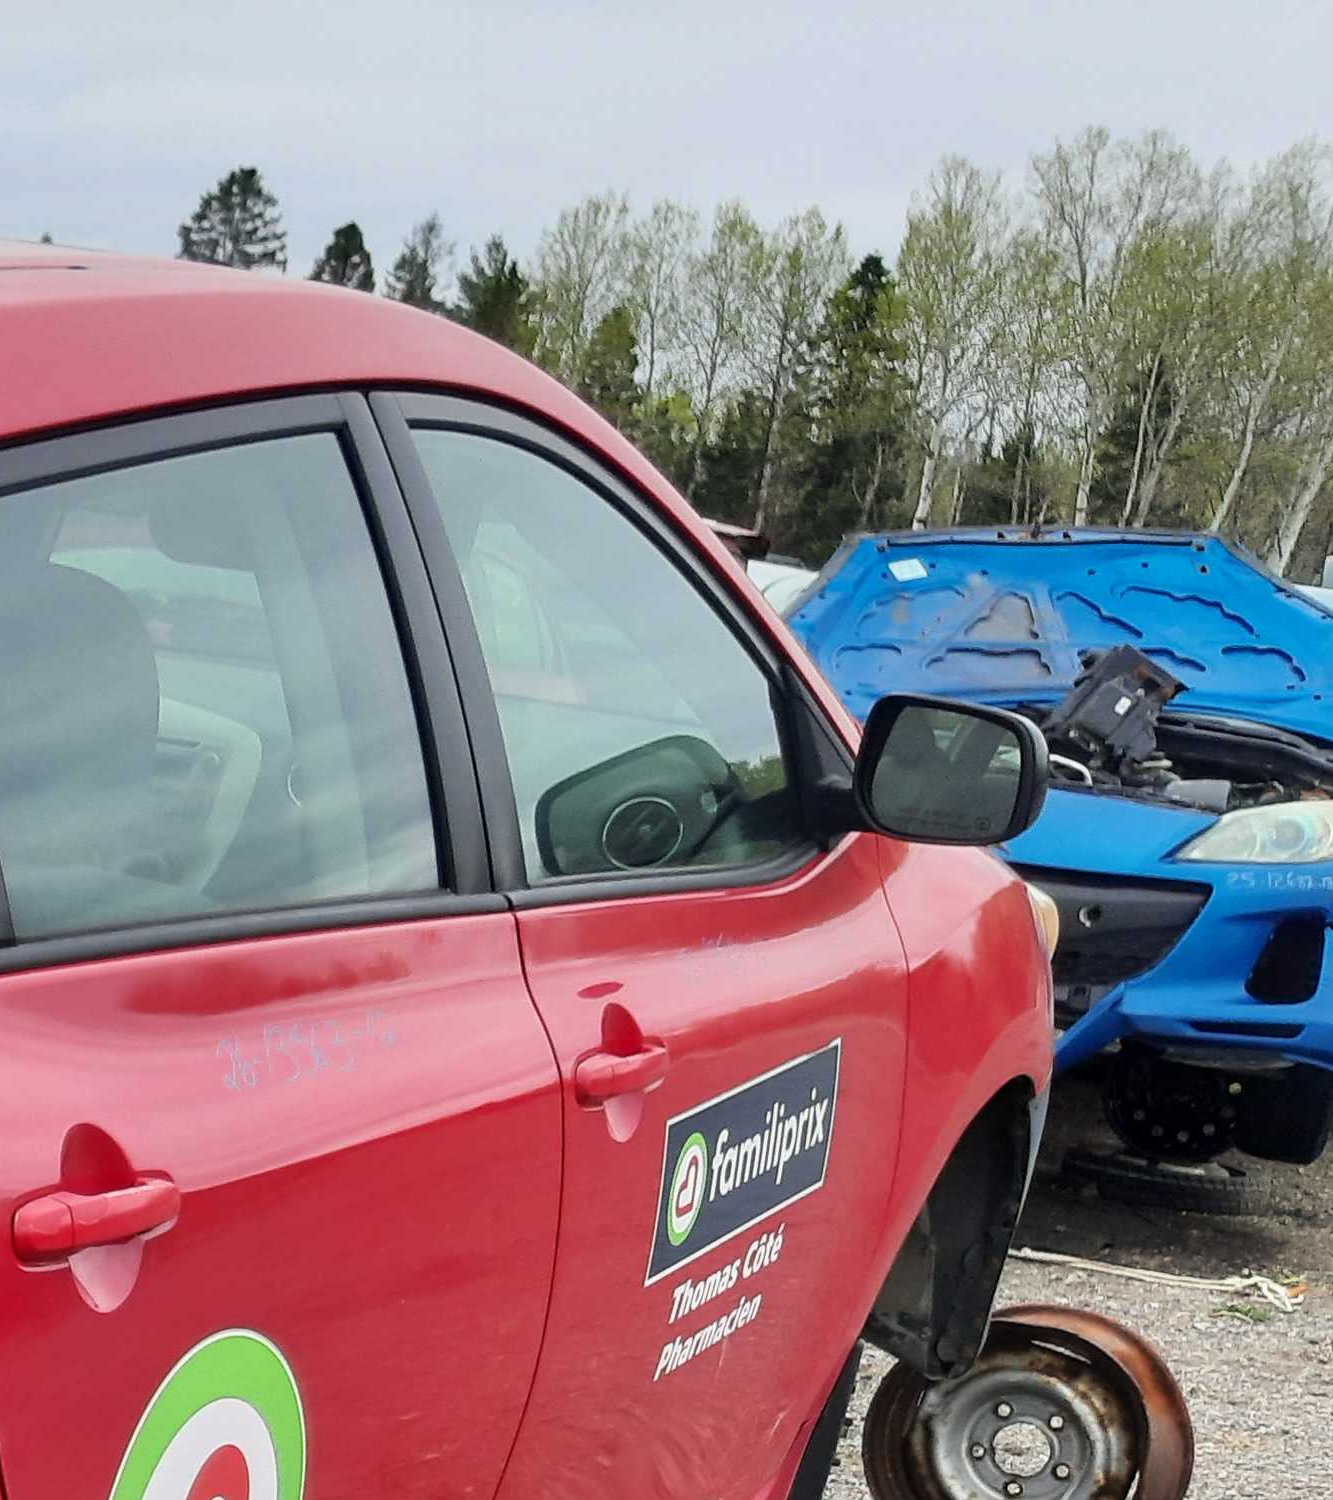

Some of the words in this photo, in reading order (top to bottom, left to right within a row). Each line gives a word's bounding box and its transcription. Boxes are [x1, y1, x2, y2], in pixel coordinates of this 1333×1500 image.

[708, 1087, 830, 1202] familiprix
[668, 1256, 739, 1325] Thomas
[741, 1223, 786, 1279] Côté
[653, 1294, 763, 1383] Pharmacien
